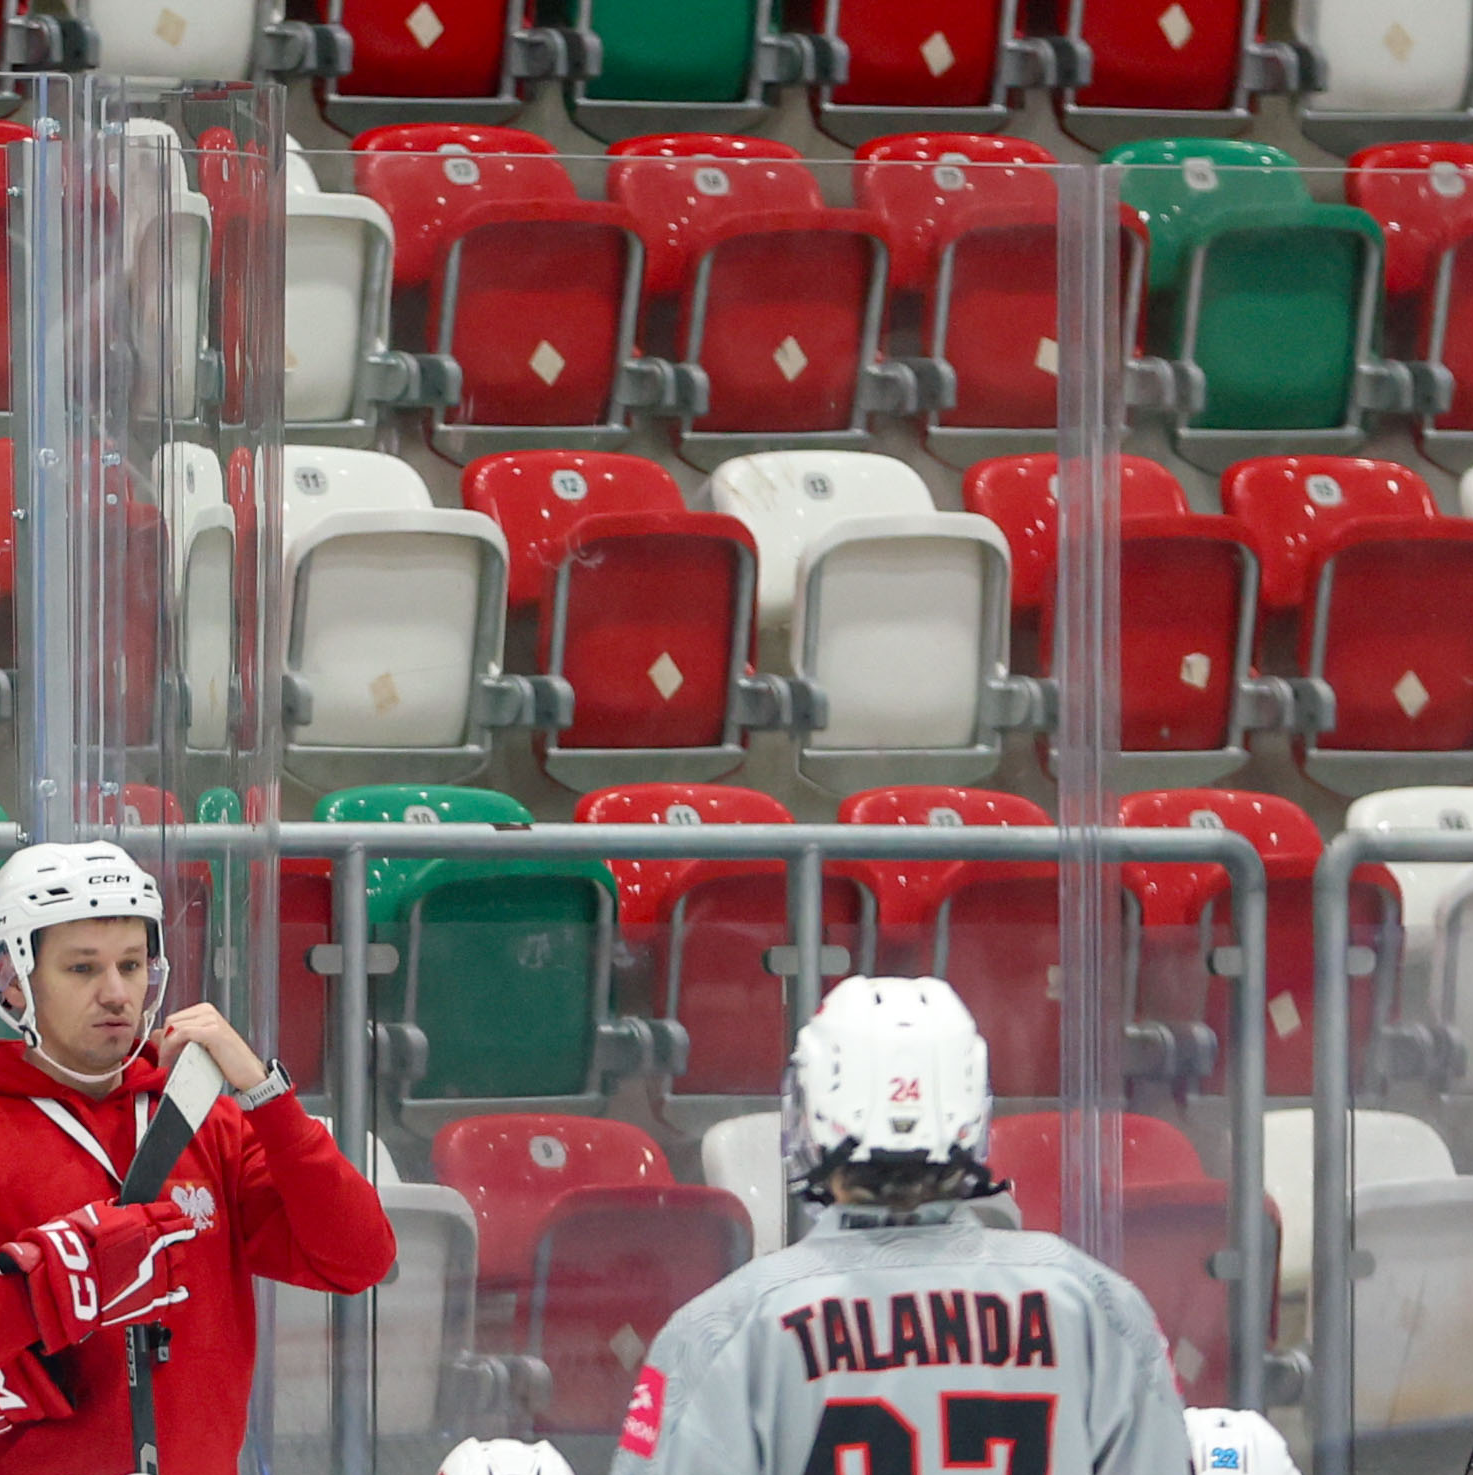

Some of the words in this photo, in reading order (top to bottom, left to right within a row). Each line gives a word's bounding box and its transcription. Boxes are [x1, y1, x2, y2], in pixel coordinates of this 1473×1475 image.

[300, 473, 320, 488] 11
[88, 874, 131, 885] CCM
[889, 1077, 921, 1102] 24
[542, 1143, 553, 1159] 9
[37, 1220, 98, 1321] CC
[782, 1290, 1058, 1382] TALANDA
[1210, 1448, 1238, 1469] 22
